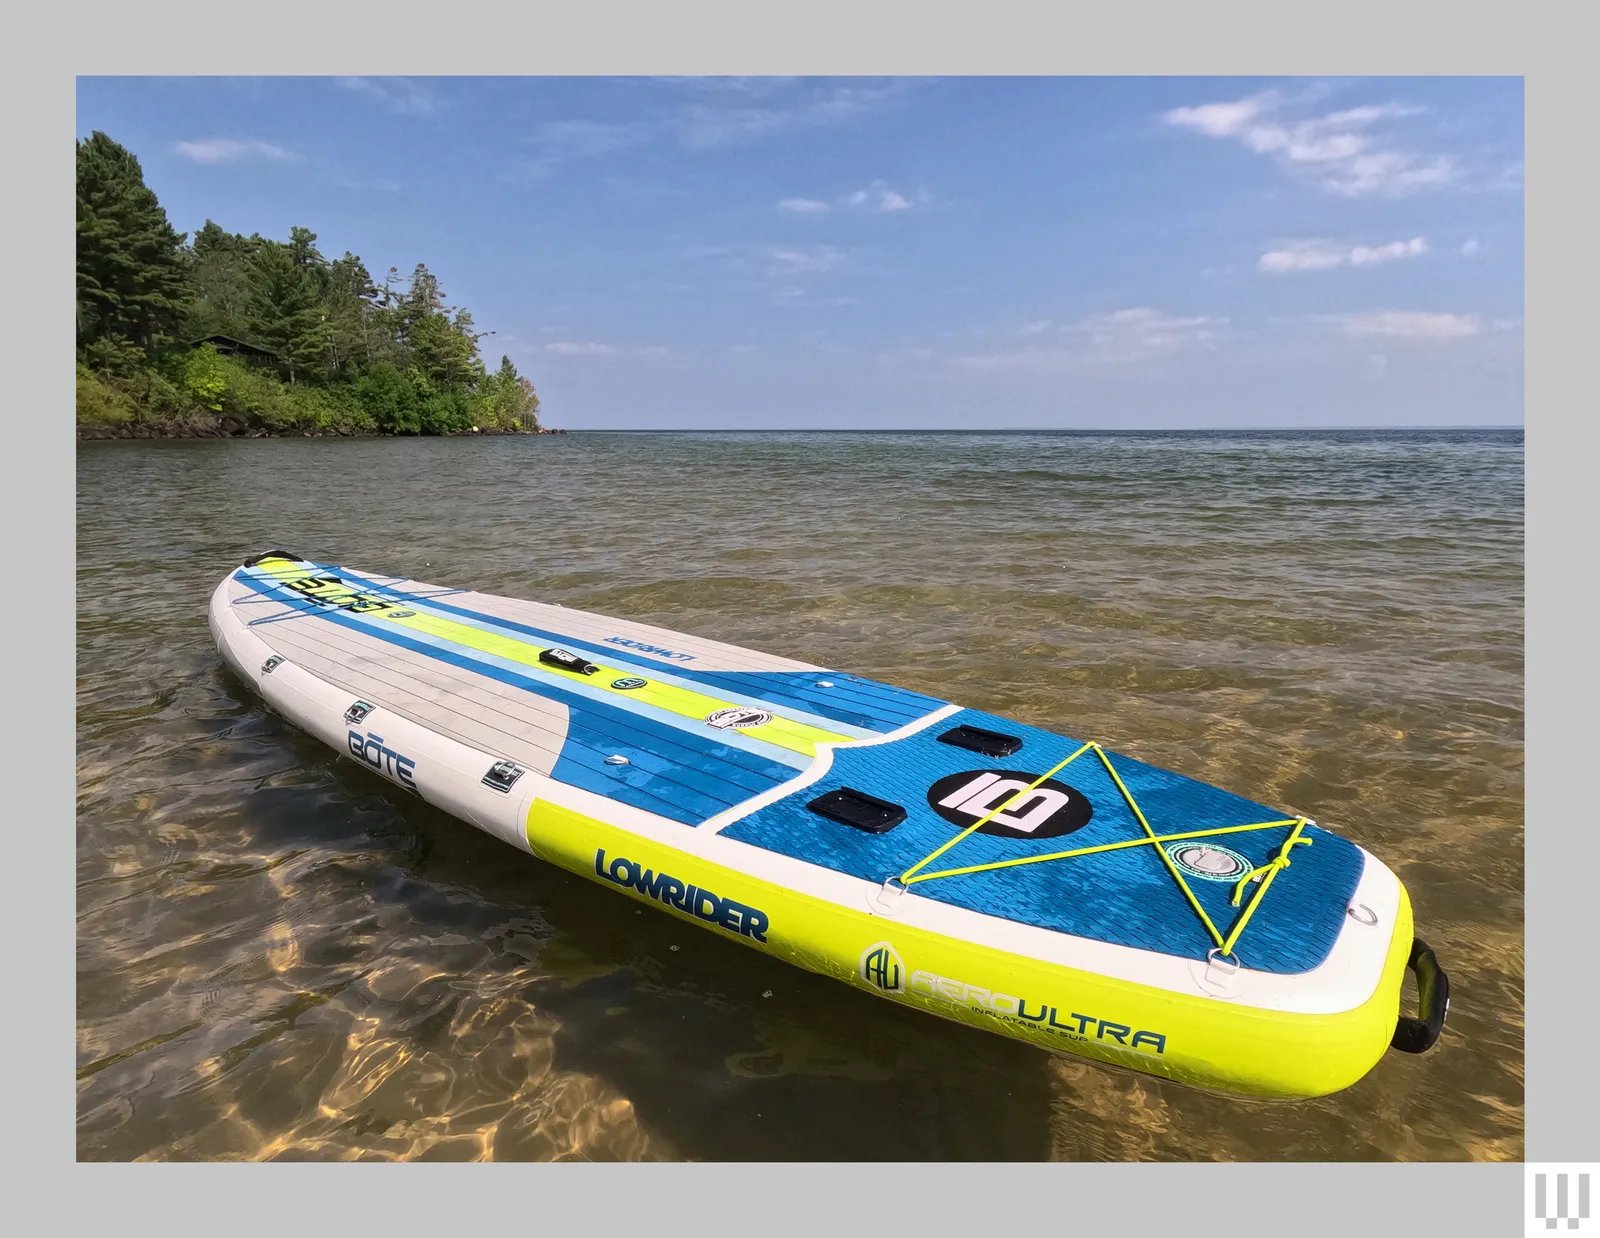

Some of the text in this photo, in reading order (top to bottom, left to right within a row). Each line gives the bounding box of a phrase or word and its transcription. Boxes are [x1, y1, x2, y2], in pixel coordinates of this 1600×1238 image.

[594, 848, 769, 945] LOWRIDER
[971, 1006, 1089, 1042] INFLATABLE SUP
